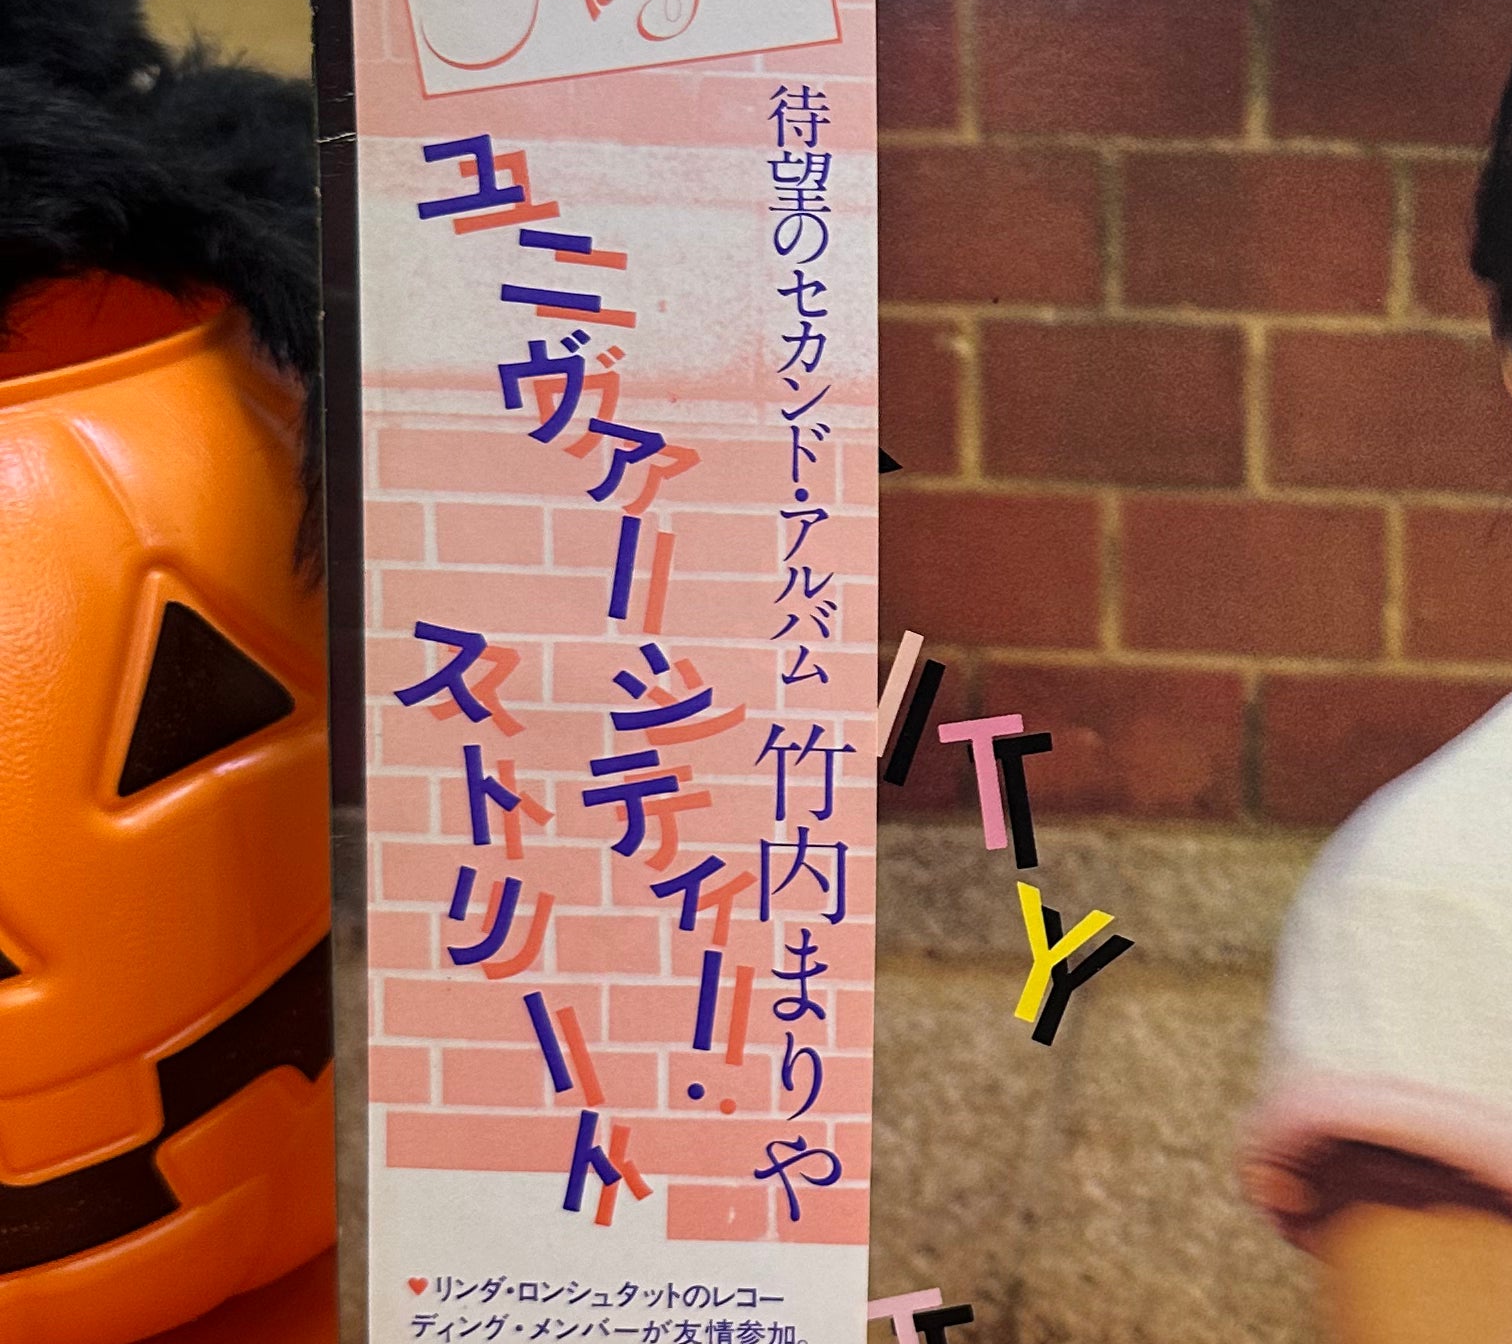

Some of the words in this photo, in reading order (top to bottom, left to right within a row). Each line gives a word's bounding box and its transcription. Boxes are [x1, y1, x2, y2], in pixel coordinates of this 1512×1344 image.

[767, 84, 838, 687] 待望のセカンド・アルバム
[392, 620, 624, 1213] ストリート
[753, 722, 858, 1223] 竹内まりや
[435, 1275, 785, 1309] リンダ・ロンシュタットのレコー
